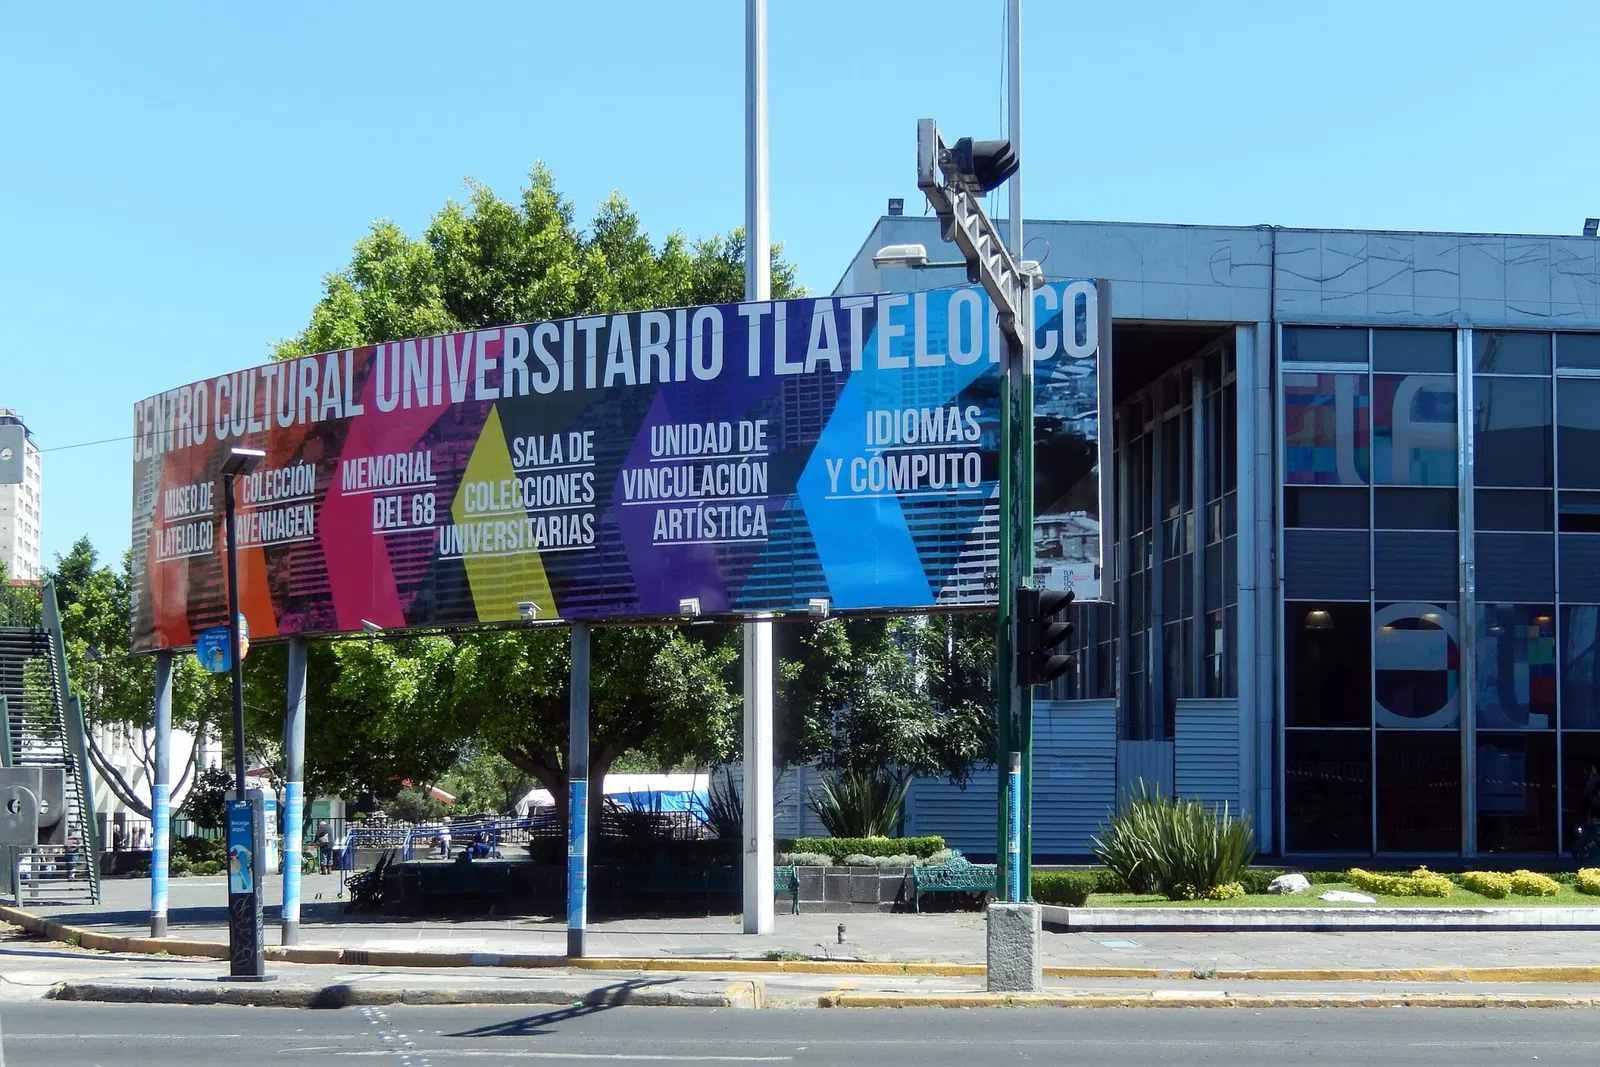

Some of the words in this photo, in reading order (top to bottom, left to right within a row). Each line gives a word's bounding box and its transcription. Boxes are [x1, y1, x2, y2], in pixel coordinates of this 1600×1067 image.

[134, 380, 208, 463] CENTRO
[215, 351, 364, 441] CULTURAL
[375, 306, 724, 413] UNIVERSITARIO
[651, 422, 732, 457] UNIDAD
[739, 419, 768, 451] DE
[866, 405, 982, 446] IDIOMAS
[513, 434, 562, 468] SALA
[569, 431, 595, 463] DE
[243, 459, 316, 504] COLECCIÓN
[342, 450, 436, 491] MEMORIAL
[622, 457, 768, 500] VINCULACIÓN
[825, 458, 844, 492] Y
[850, 449, 982, 492] CÓMPUTO
[165, 484, 197, 519] MUSEO
[200, 481, 214, 511] DE
[373, 496, 407, 530] DEL
[412, 492, 436, 526] 68
[464, 471, 596, 513] COLECCIONES
[156, 520, 214, 558] TLATELOLCO
[224, 504, 314, 547] AVENHAGEN
[439, 513, 596, 555] UNIVERSITARIAS
[653, 502, 768, 540] ARTÍSTICA
